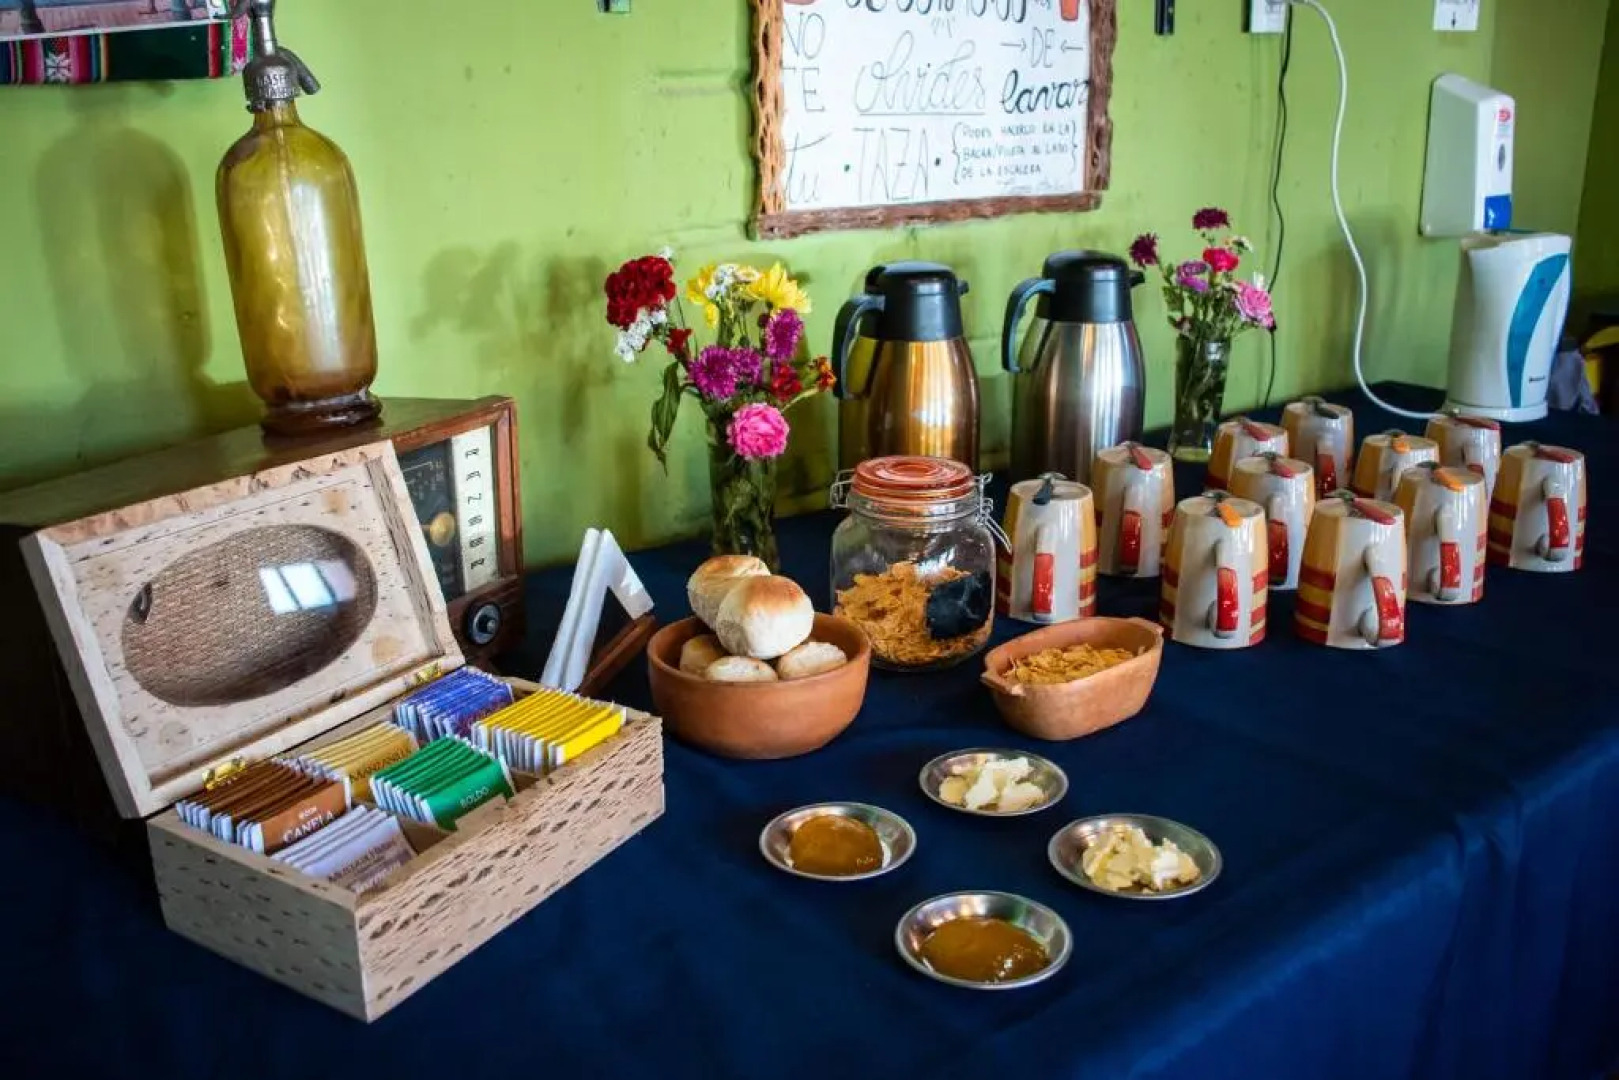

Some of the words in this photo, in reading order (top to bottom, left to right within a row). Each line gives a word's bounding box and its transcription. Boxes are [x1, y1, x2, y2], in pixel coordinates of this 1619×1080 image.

[783, 12, 825, 60] NO
[1031, 26, 1055, 68] DE
[853, 127, 929, 203] TAZA
[980, 167, 992, 177] LA
